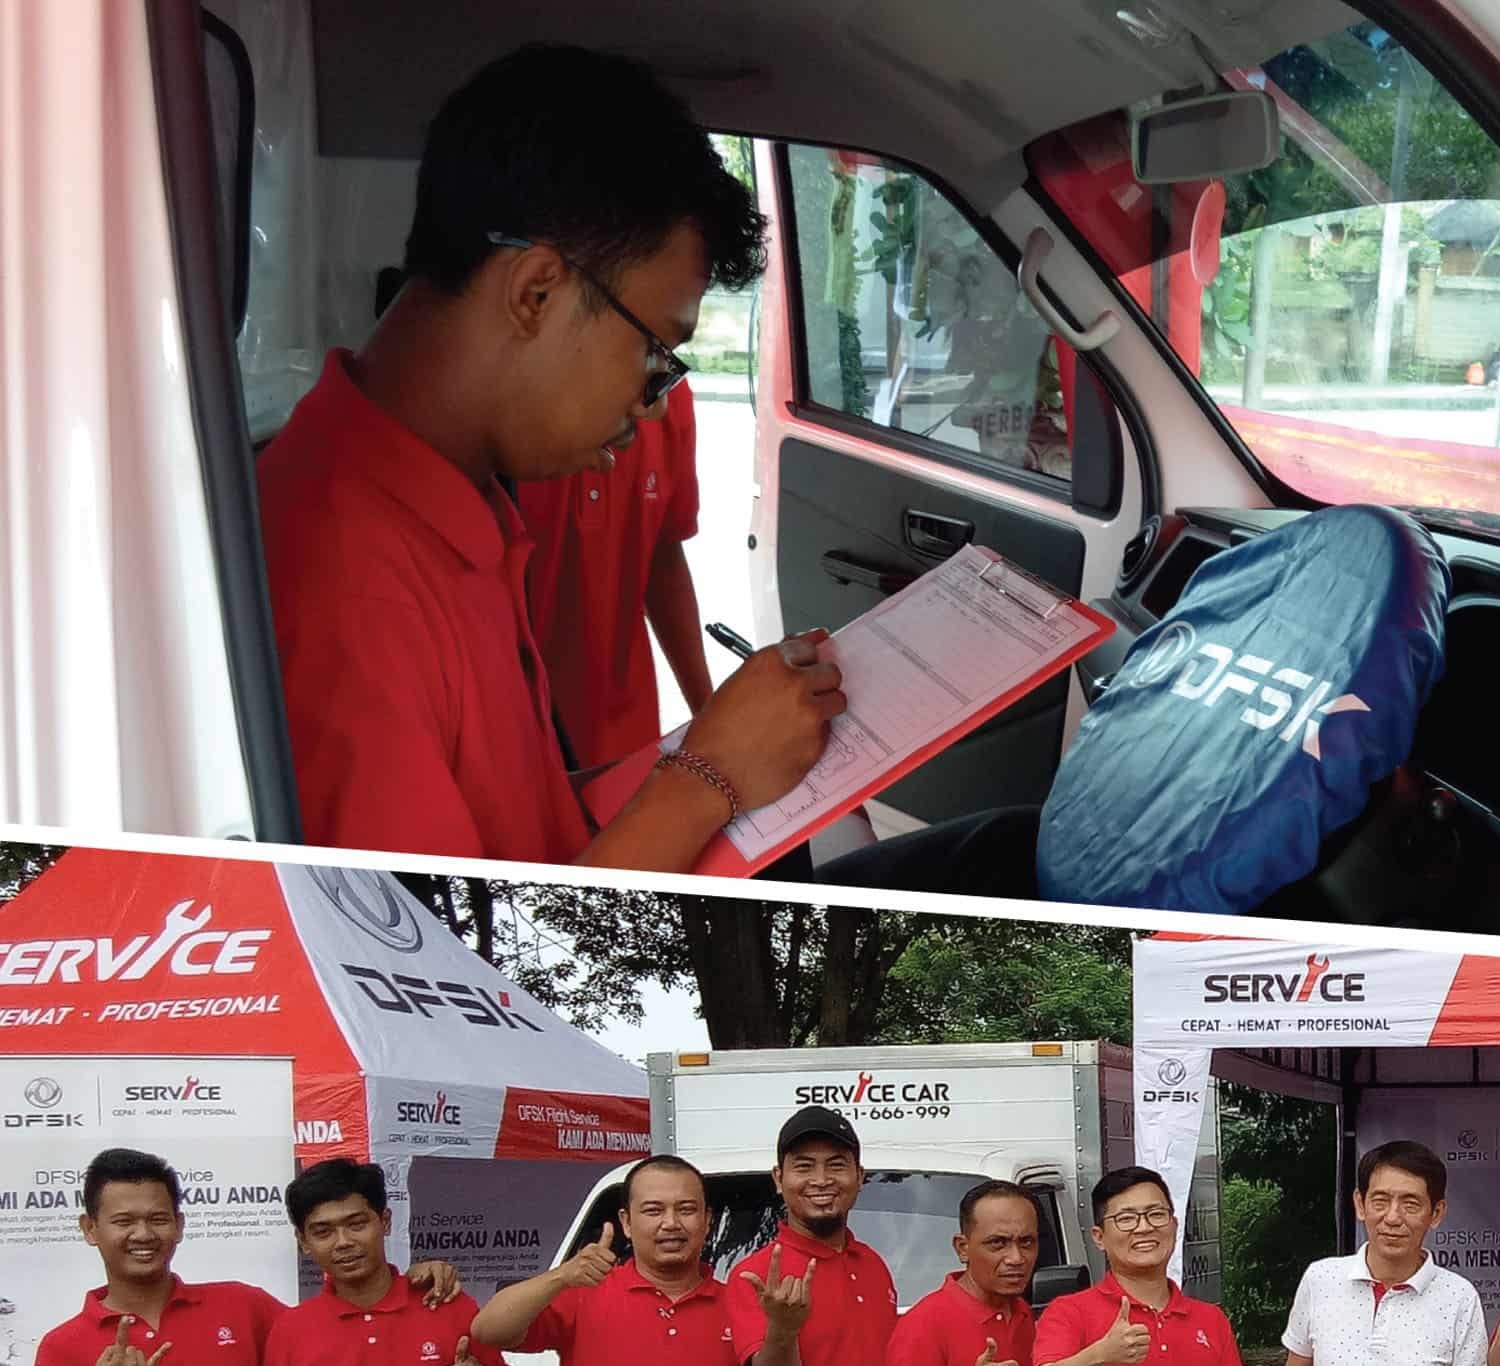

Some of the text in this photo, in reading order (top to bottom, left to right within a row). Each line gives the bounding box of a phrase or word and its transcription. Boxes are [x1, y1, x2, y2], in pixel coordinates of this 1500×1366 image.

[1169, 644, 1372, 762] DFSK
[1204, 953, 1365, 1003] SERVICE
[340, 963, 545, 1032] DFSK
[98, 995, 281, 1023] PROFESIONAL
[1181, 1018, 1391, 1032] CEPAT HEMAT PROFESIONAL
[125, 1075, 222, 1101] SERVICE
[795, 1071, 950, 1104] SERVICE CAR
[1143, 1091, 1200, 1103] DFSK
[397, 1090, 462, 1125] SERVICE
[518, 1104, 545, 1122] DFSK
[4, 1113, 86, 1128] DFSK
[558, 1128, 585, 1150] KAMI
[586, 1129, 606, 1150] ADA
[1447, 1151, 1488, 1161] DFSK
[25, 1190, 69, 1209] ADA
[226, 1186, 283, 1204] ANDA
[430, 1212, 484, 1227] Service
[493, 1229, 540, 1247] ANDA
[1436, 1231, 1478, 1245] DFSK
